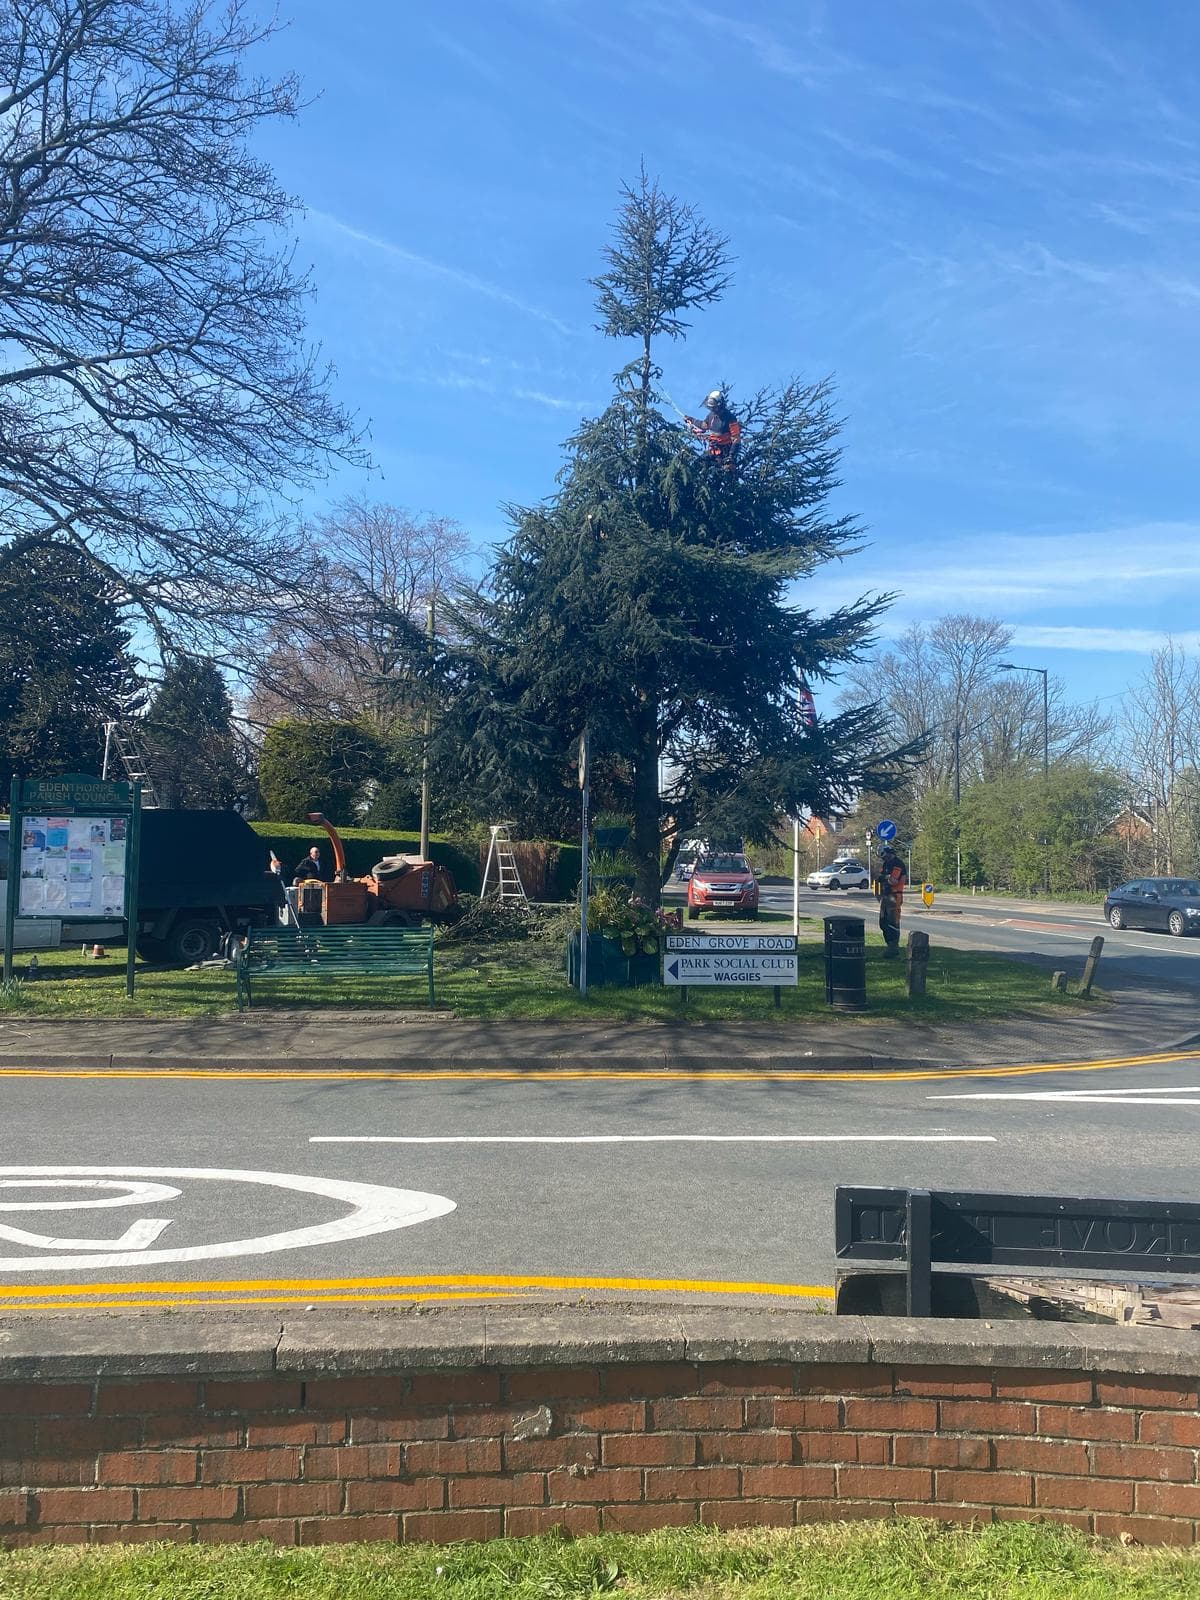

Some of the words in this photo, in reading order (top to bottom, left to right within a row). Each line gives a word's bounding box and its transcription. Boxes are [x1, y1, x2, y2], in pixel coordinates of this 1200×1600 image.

[38, 782, 115, 792] EDENTHORPE
[29, 791, 70, 801] PARISH
[74, 792, 120, 802] COUNCIL
[669, 937, 701, 948] EDEN
[708, 937, 749, 949] GROVE
[758, 938, 793, 949] ROAD
[681, 958, 711, 969] PARK
[714, 958, 758, 969] SOCIAL
[761, 958, 794, 969] CLUB
[714, 972, 761, 982] WAGGIES
